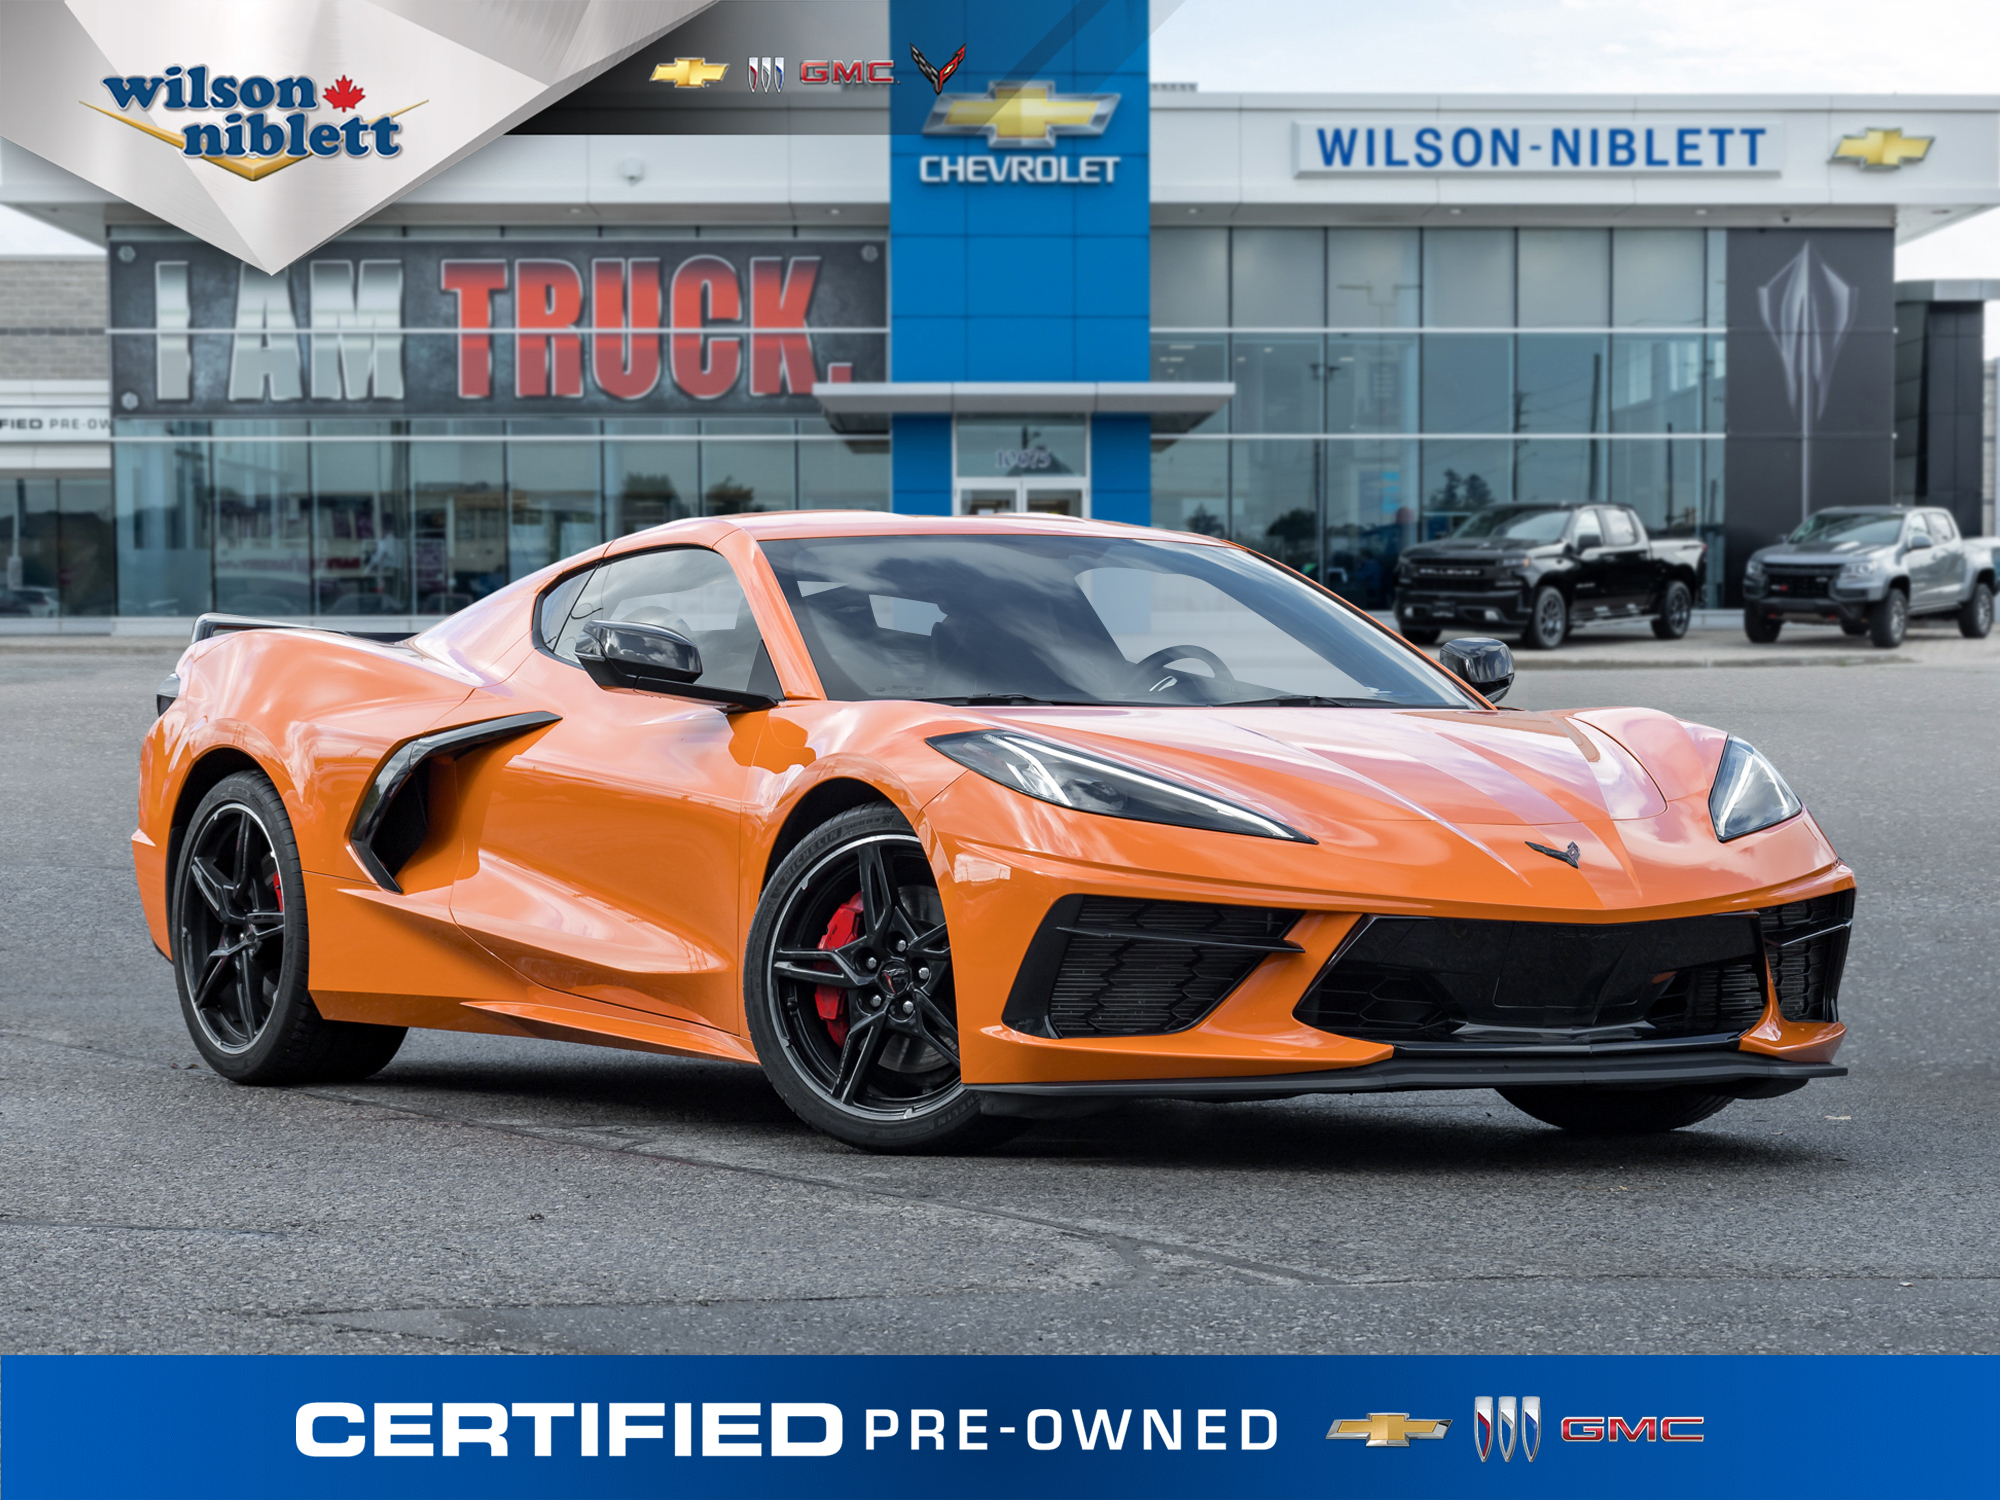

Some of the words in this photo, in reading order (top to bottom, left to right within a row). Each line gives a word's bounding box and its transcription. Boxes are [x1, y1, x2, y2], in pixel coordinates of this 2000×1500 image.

[1316, 127, 1767, 168] WILSON-NIBLETT
[919, 155, 1121, 183] CHEVROLET
[155, 261, 191, 401] I
[228, 260, 403, 401] AM
[440, 254, 853, 401] TRUCK.
